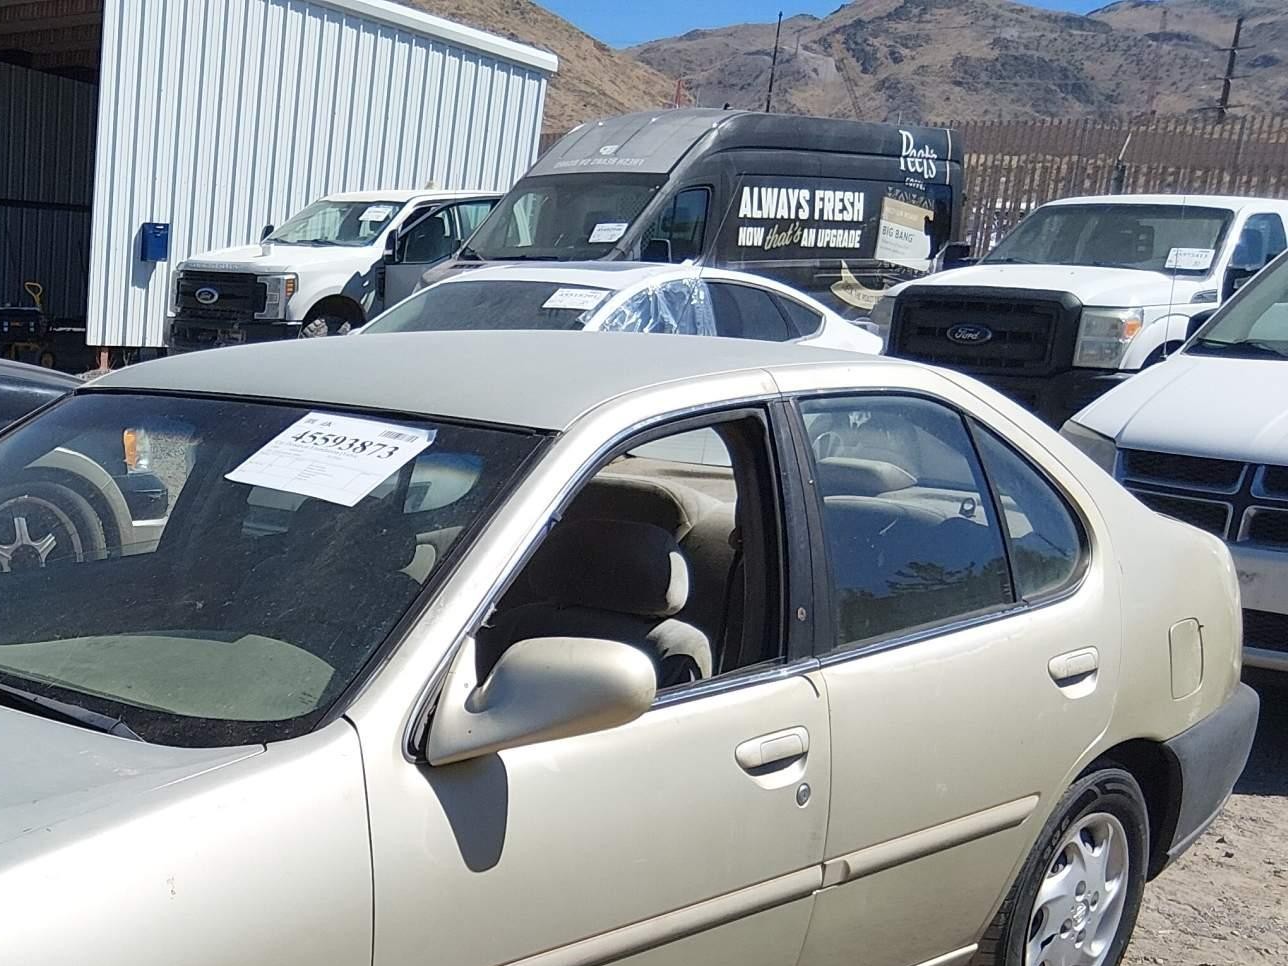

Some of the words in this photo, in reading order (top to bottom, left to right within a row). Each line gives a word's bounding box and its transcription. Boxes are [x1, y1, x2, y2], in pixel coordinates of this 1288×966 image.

[899, 129, 937, 178] Peet's
[738, 186, 810, 220] ALWAYS
[814, 190, 864, 221] FRESH
[738, 227, 764, 246] NOW
[764, 221, 802, 250] that's
[800, 228, 816, 247] AN
[817, 229, 862, 248] UPGRADE
[882, 225, 893, 237] BIG
[895, 229, 913, 242] BANG
[954, 327, 981, 340] Ford
[292, 430, 400, 459] 45593873
